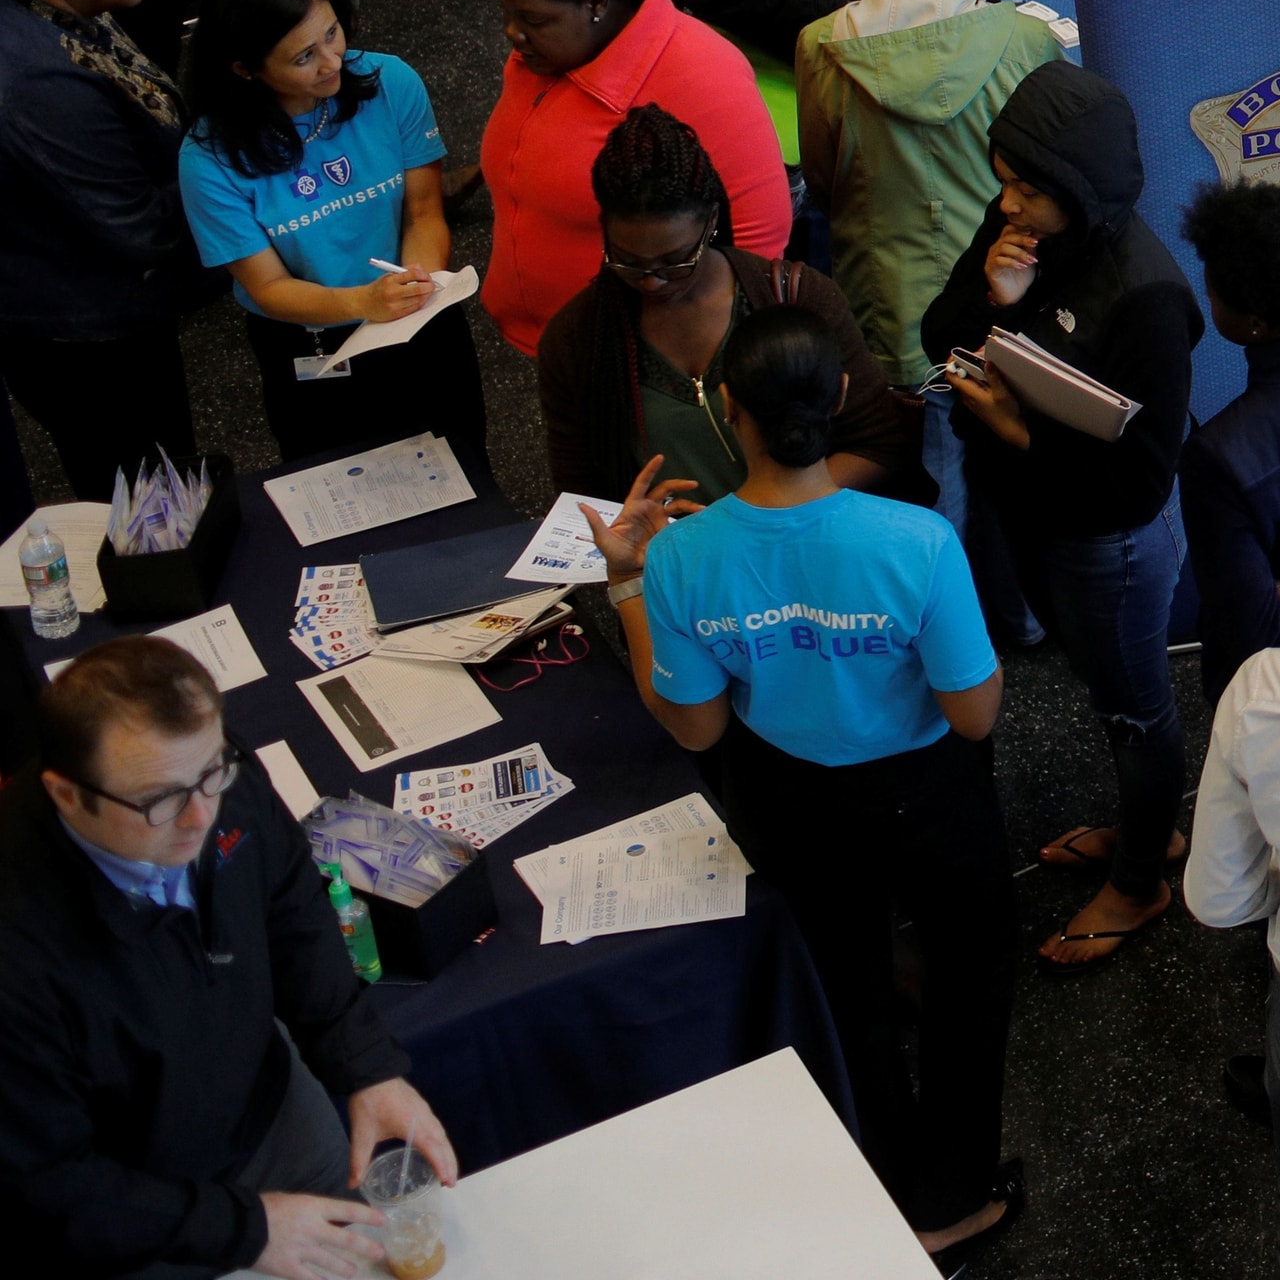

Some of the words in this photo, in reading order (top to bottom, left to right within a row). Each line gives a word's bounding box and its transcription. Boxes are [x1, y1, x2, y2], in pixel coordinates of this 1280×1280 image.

[696, 616, 742, 637] ONE
[709, 633, 779, 664] ONE
[790, 625, 890, 663] BLUE
